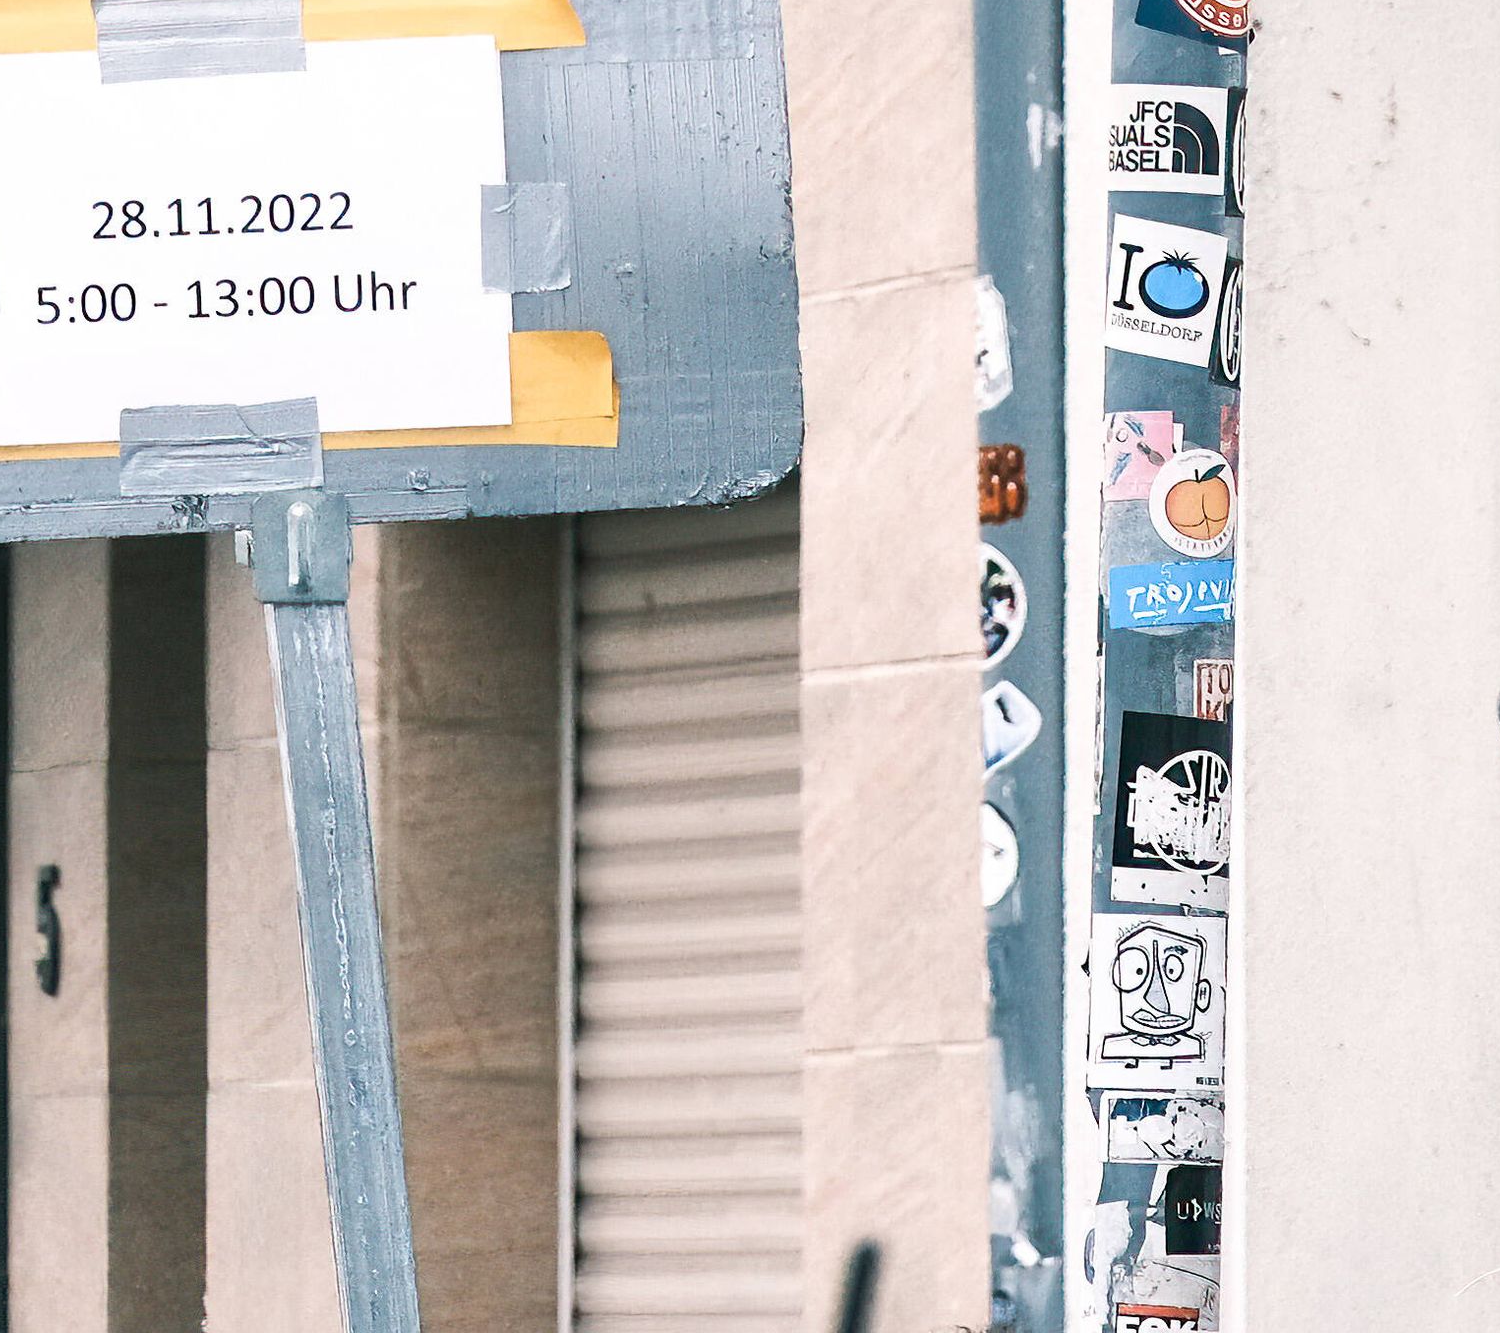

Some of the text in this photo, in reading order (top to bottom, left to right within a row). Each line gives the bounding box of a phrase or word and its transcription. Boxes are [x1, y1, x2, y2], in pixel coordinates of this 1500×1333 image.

[1130, 101, 1173, 123] JFC
[1109, 149, 1169, 172] BASEL
[91, 191, 353, 239] 28.11.2022
[1112, 242, 1144, 311] I
[36, 283, 137, 324] 5:00
[187, 275, 315, 320] 13:00
[333, 270, 418, 314] Uhr
[1111, 313, 1202, 342] DÜSSELDORF
